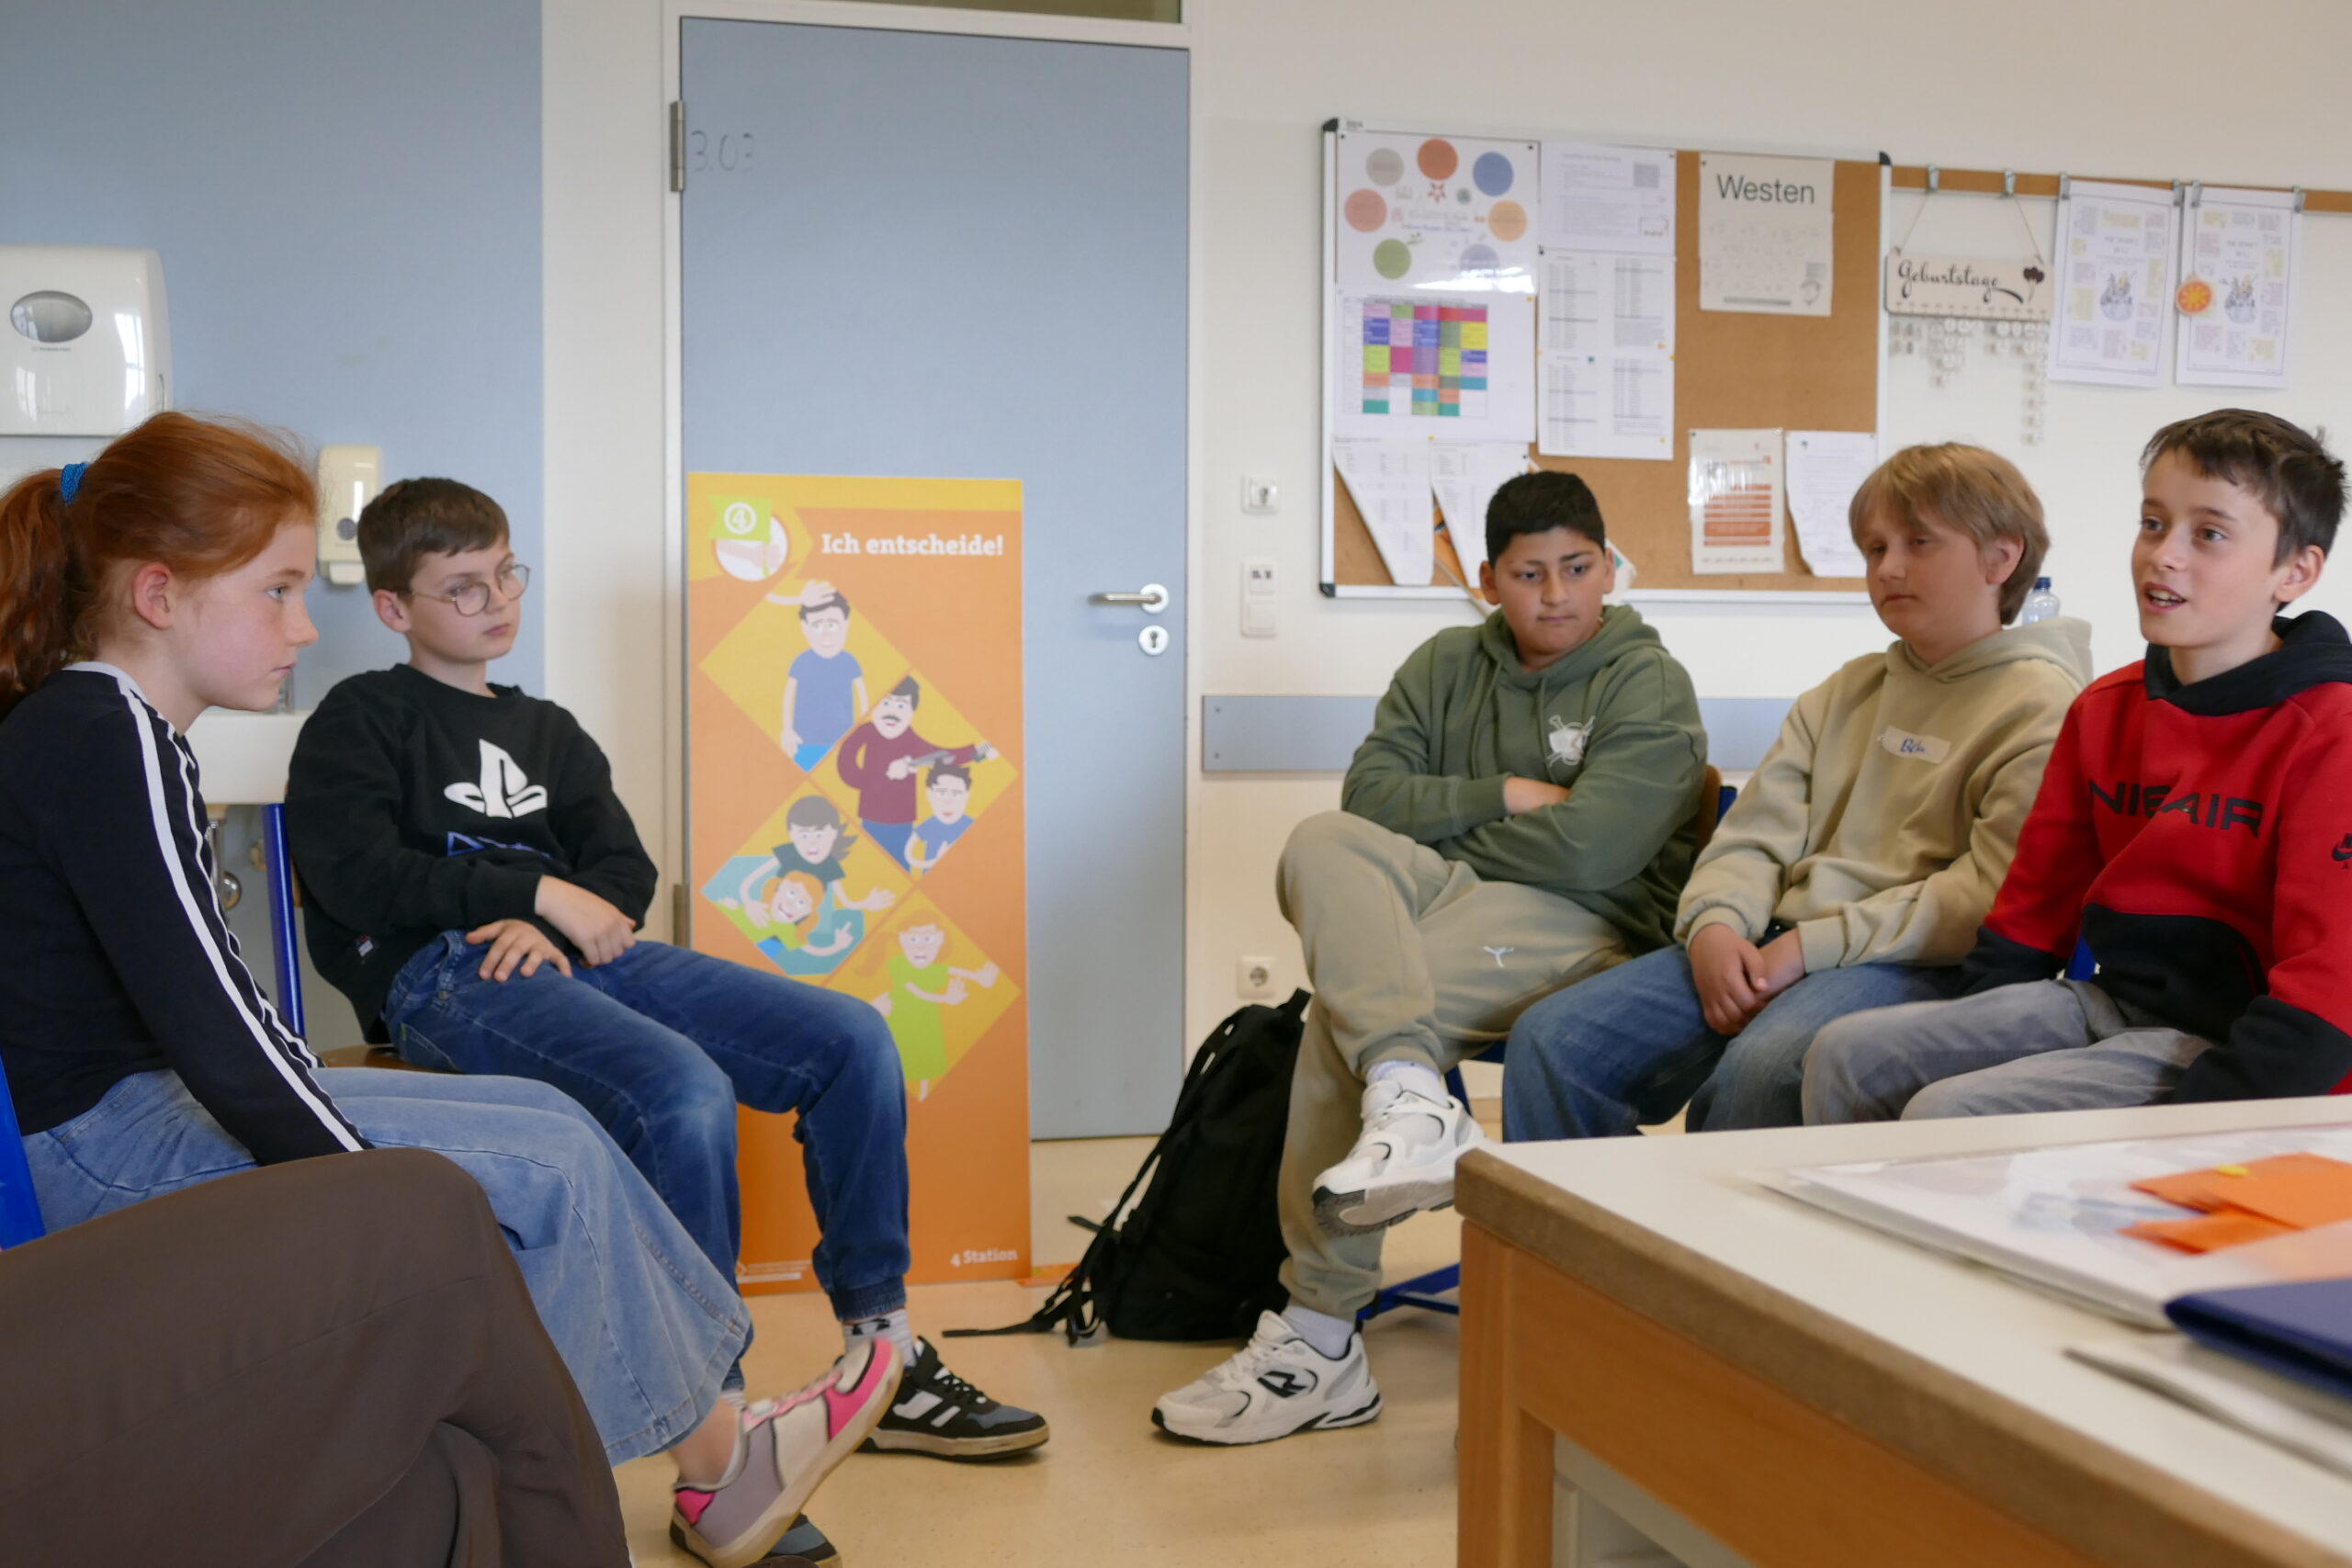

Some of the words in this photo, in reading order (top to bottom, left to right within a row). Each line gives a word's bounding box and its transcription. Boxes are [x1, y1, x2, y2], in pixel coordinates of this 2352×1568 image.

[1716, 173, 1815, 204] Westen
[1897, 259, 2024, 304] Geburtstage
[732, 508, 749, 531] 4
[821, 532, 861, 555] Ich
[865, 534, 1004, 556] entscheide!
[963, 1247, 1018, 1265] Station
